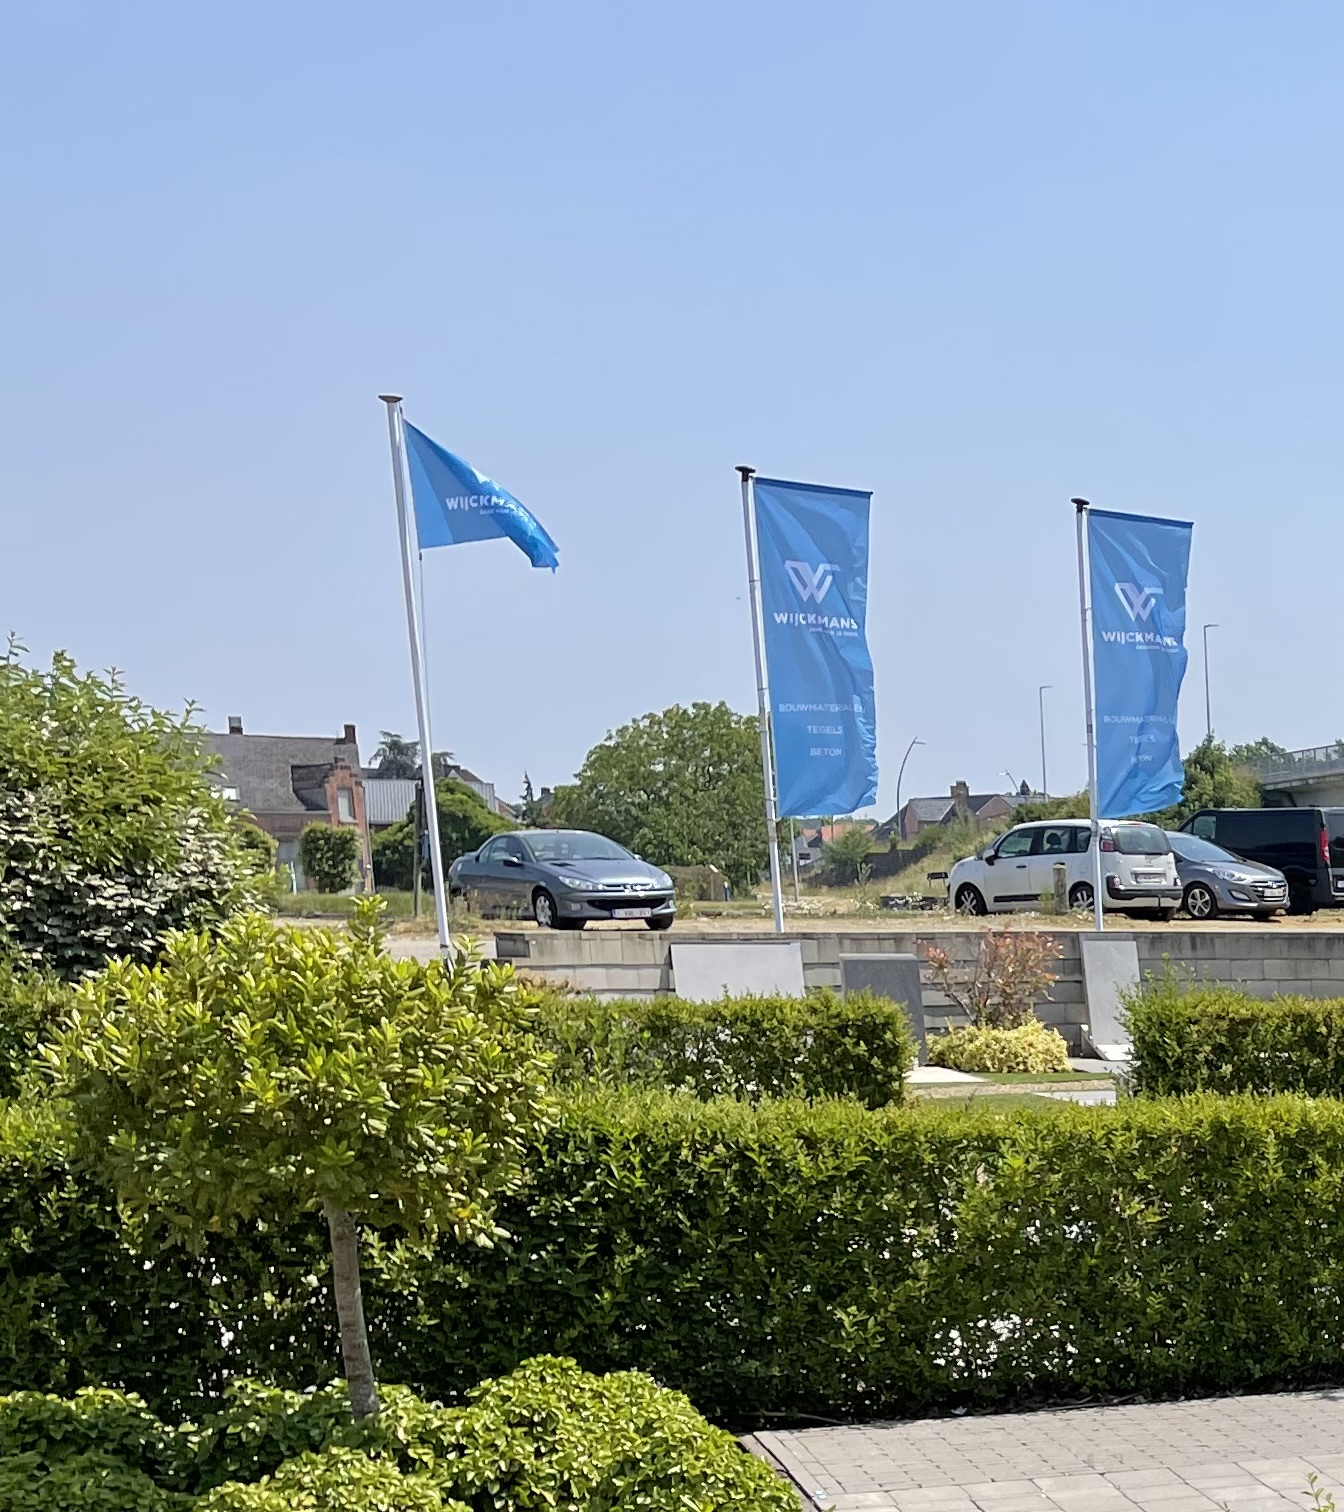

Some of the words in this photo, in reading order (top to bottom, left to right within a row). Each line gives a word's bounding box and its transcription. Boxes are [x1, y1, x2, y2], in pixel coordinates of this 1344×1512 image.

[445, 495, 517, 512] WIJCKM
[773, 612, 858, 630] WIJCKMANS
[806, 724, 844, 735] TEGELS
[809, 747, 842, 757] BETON
